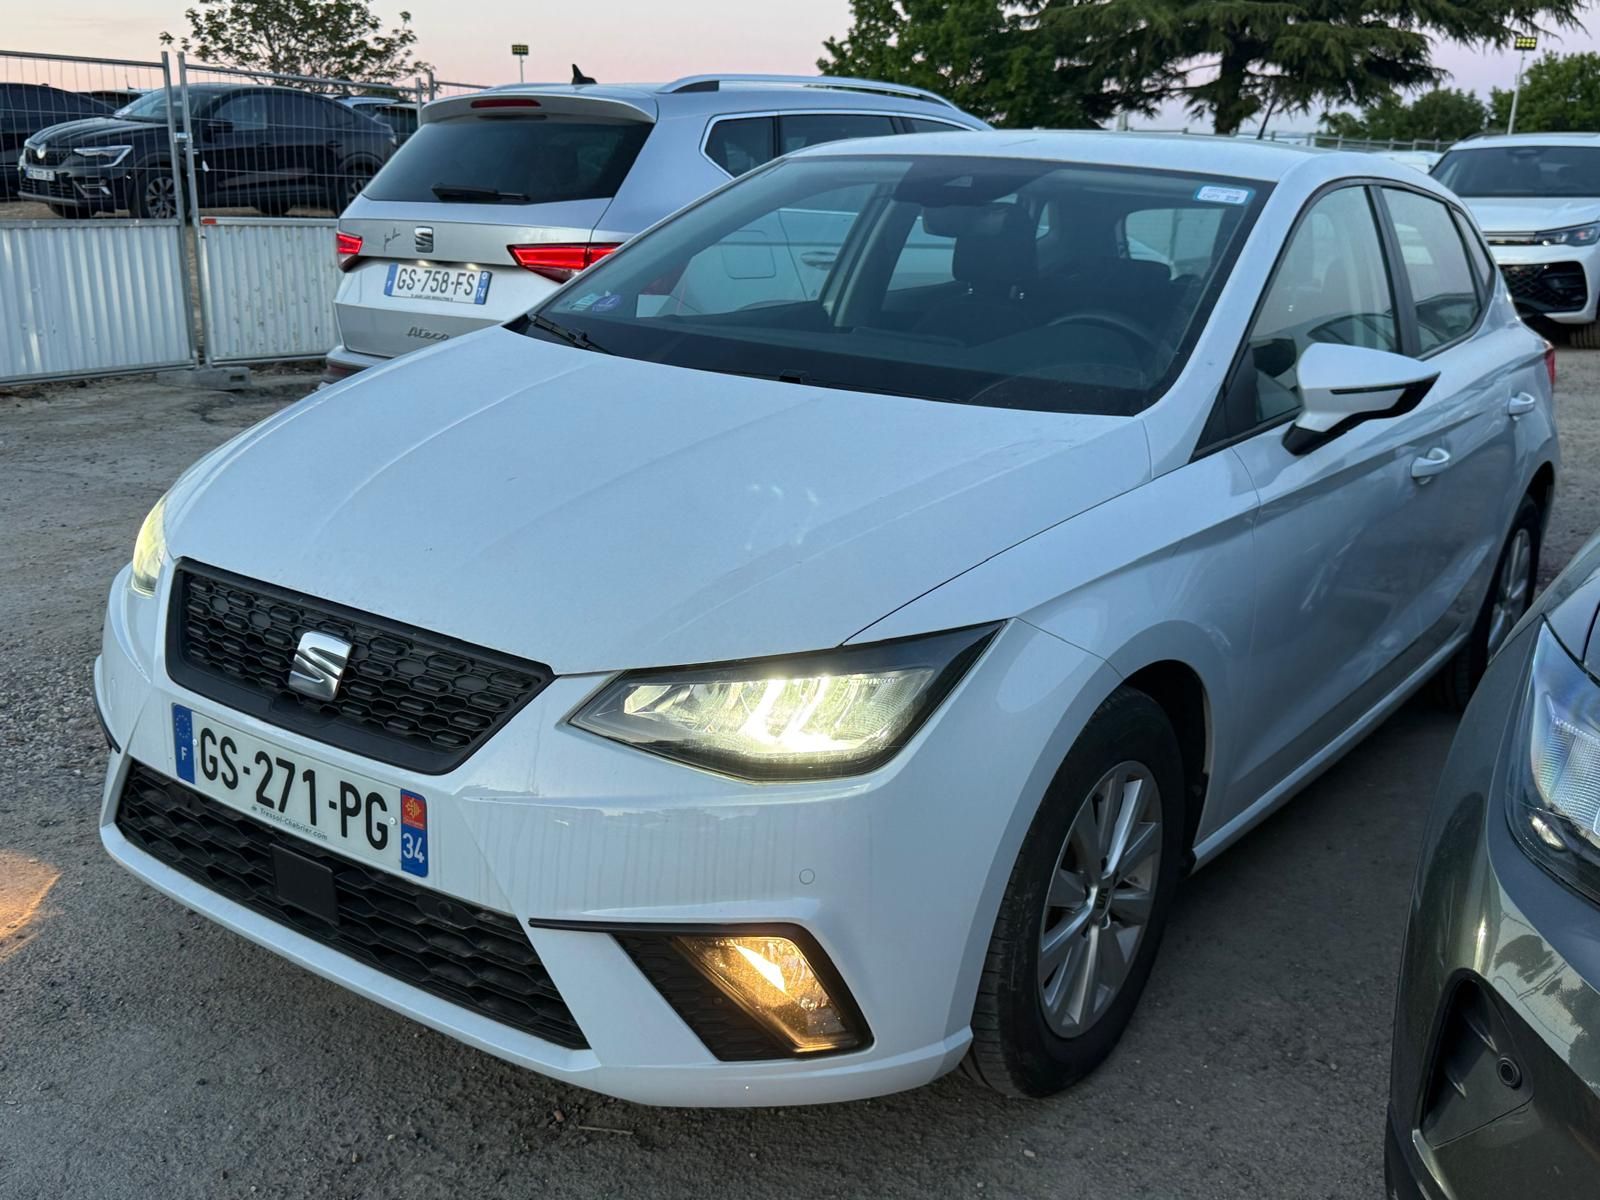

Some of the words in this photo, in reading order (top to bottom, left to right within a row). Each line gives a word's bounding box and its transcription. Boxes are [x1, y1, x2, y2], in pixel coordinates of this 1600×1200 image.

[396, 267, 476, 297] GS-758-FS
[407, 326, 450, 341] Ateco
[180, 746, 188, 761] F
[200, 727, 389, 851] GS-271-PG
[402, 832, 425, 864] 34
